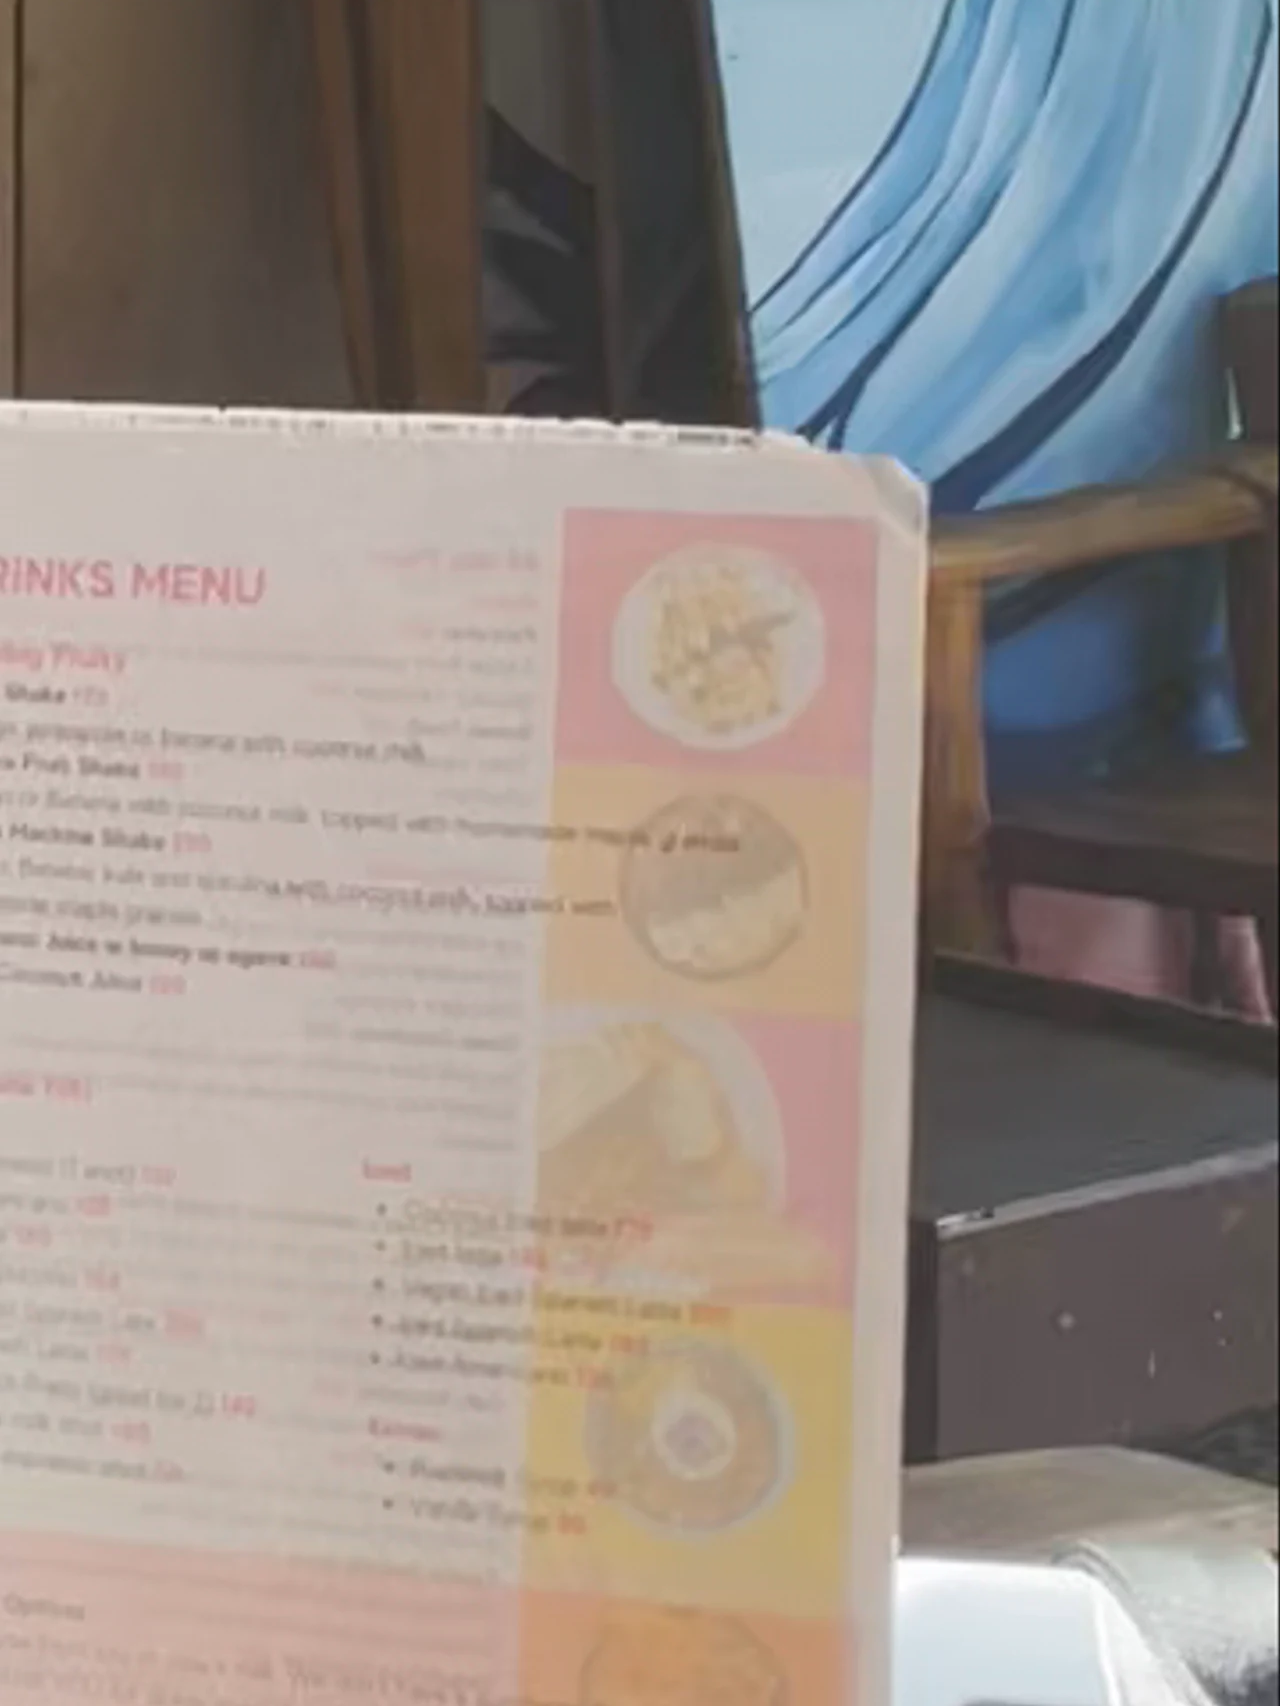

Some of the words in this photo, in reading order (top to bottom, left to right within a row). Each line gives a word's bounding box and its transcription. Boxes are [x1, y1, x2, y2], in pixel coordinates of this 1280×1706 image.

[131, 563, 267, 606] MENU
[5, 682, 66, 705] Shake
[79, 757, 140, 779] Shake
[9, 822, 95, 846] Machine
[101, 828, 167, 851] Shake
[321, 809, 399, 835] topped
[45, 931, 97, 955] Juice
[128, 937, 192, 965] honey
[1, 1592, 85, 1622] Options
